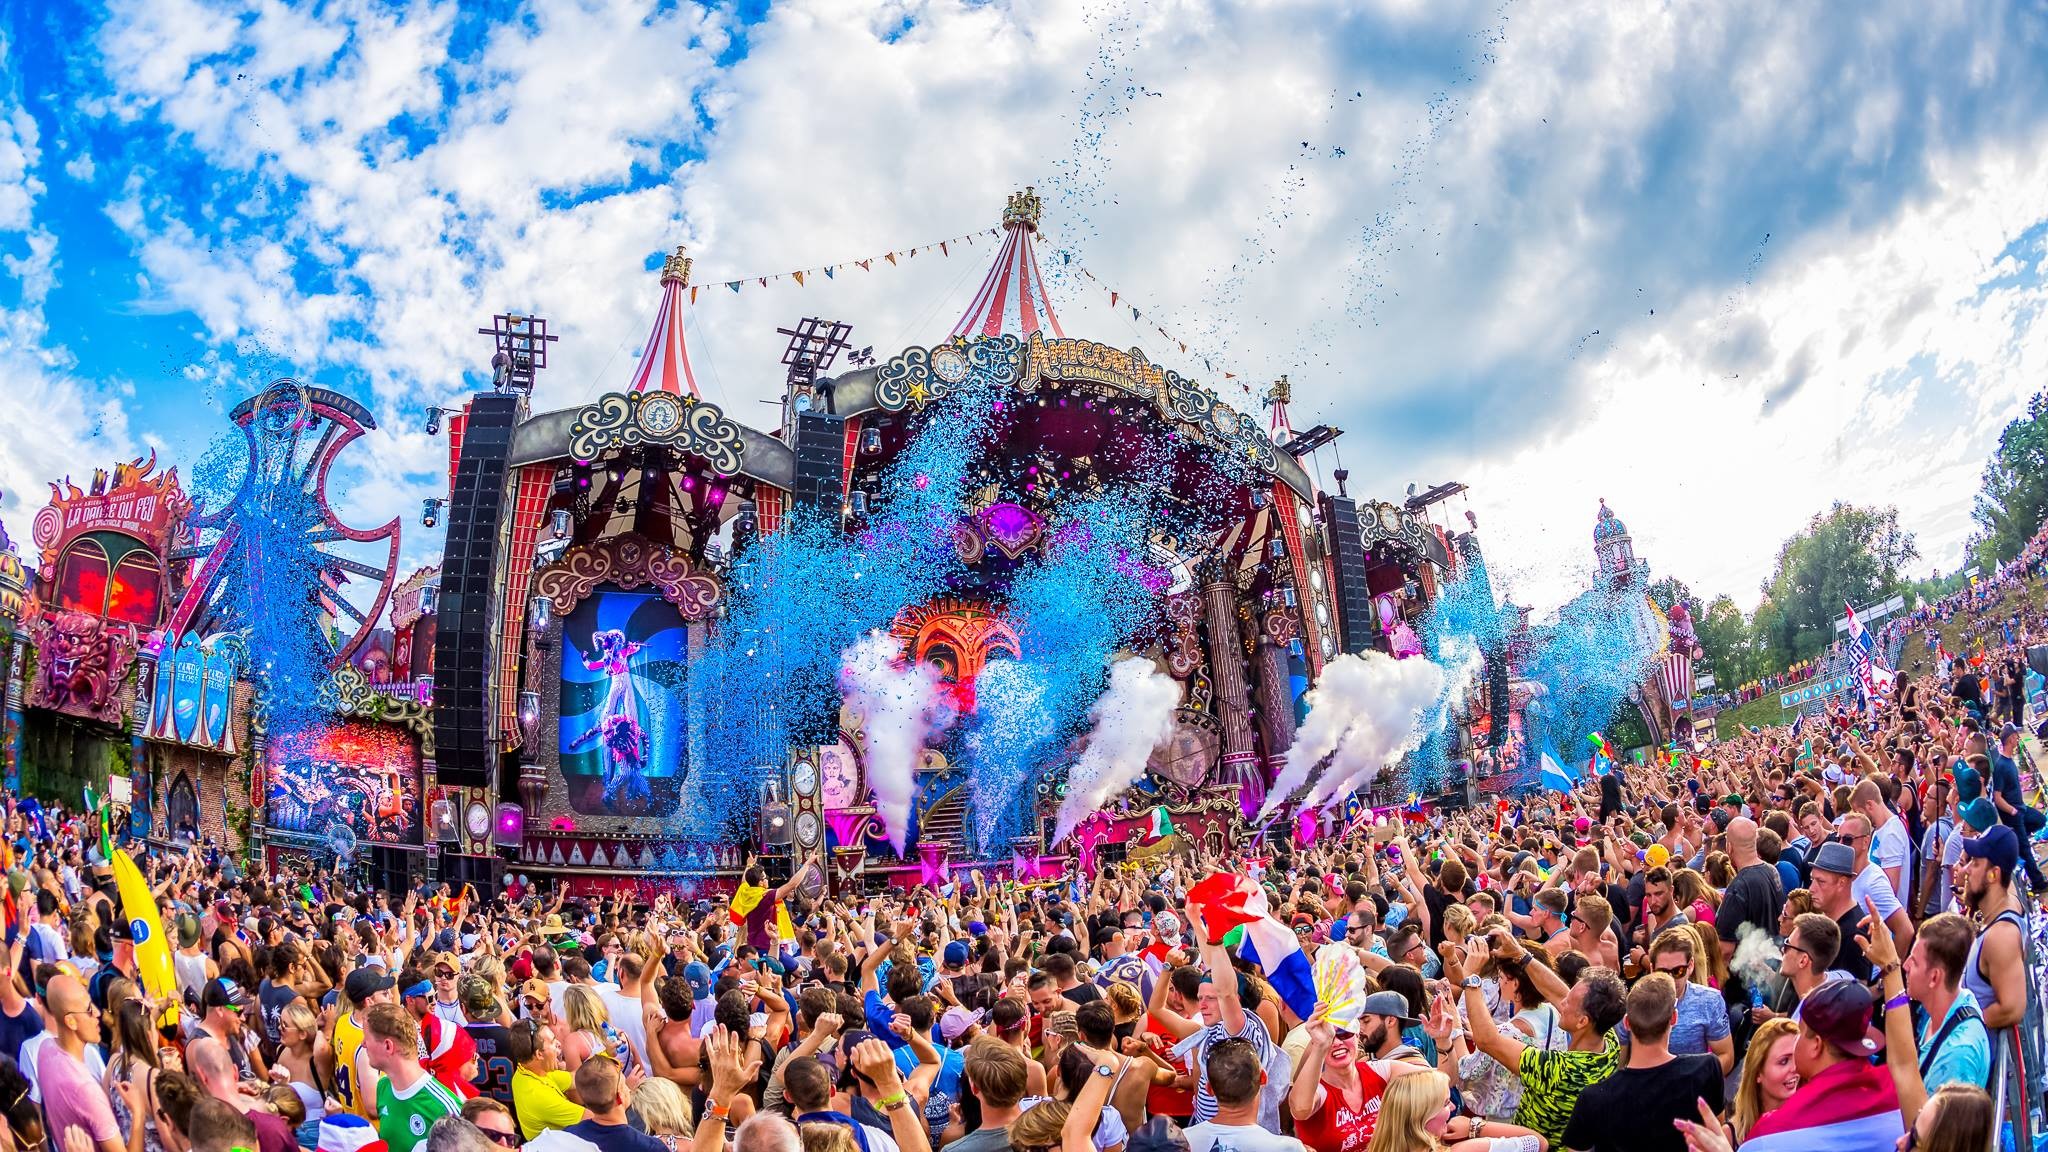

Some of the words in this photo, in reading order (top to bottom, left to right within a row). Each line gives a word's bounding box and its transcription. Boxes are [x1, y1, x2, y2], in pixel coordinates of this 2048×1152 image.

[1020, 331, 1175, 419] AMICORUM
[1061, 365, 1136, 391] SPECTACULUM
[66, 508, 82, 528] LA
[134, 495, 157, 522] FEU
